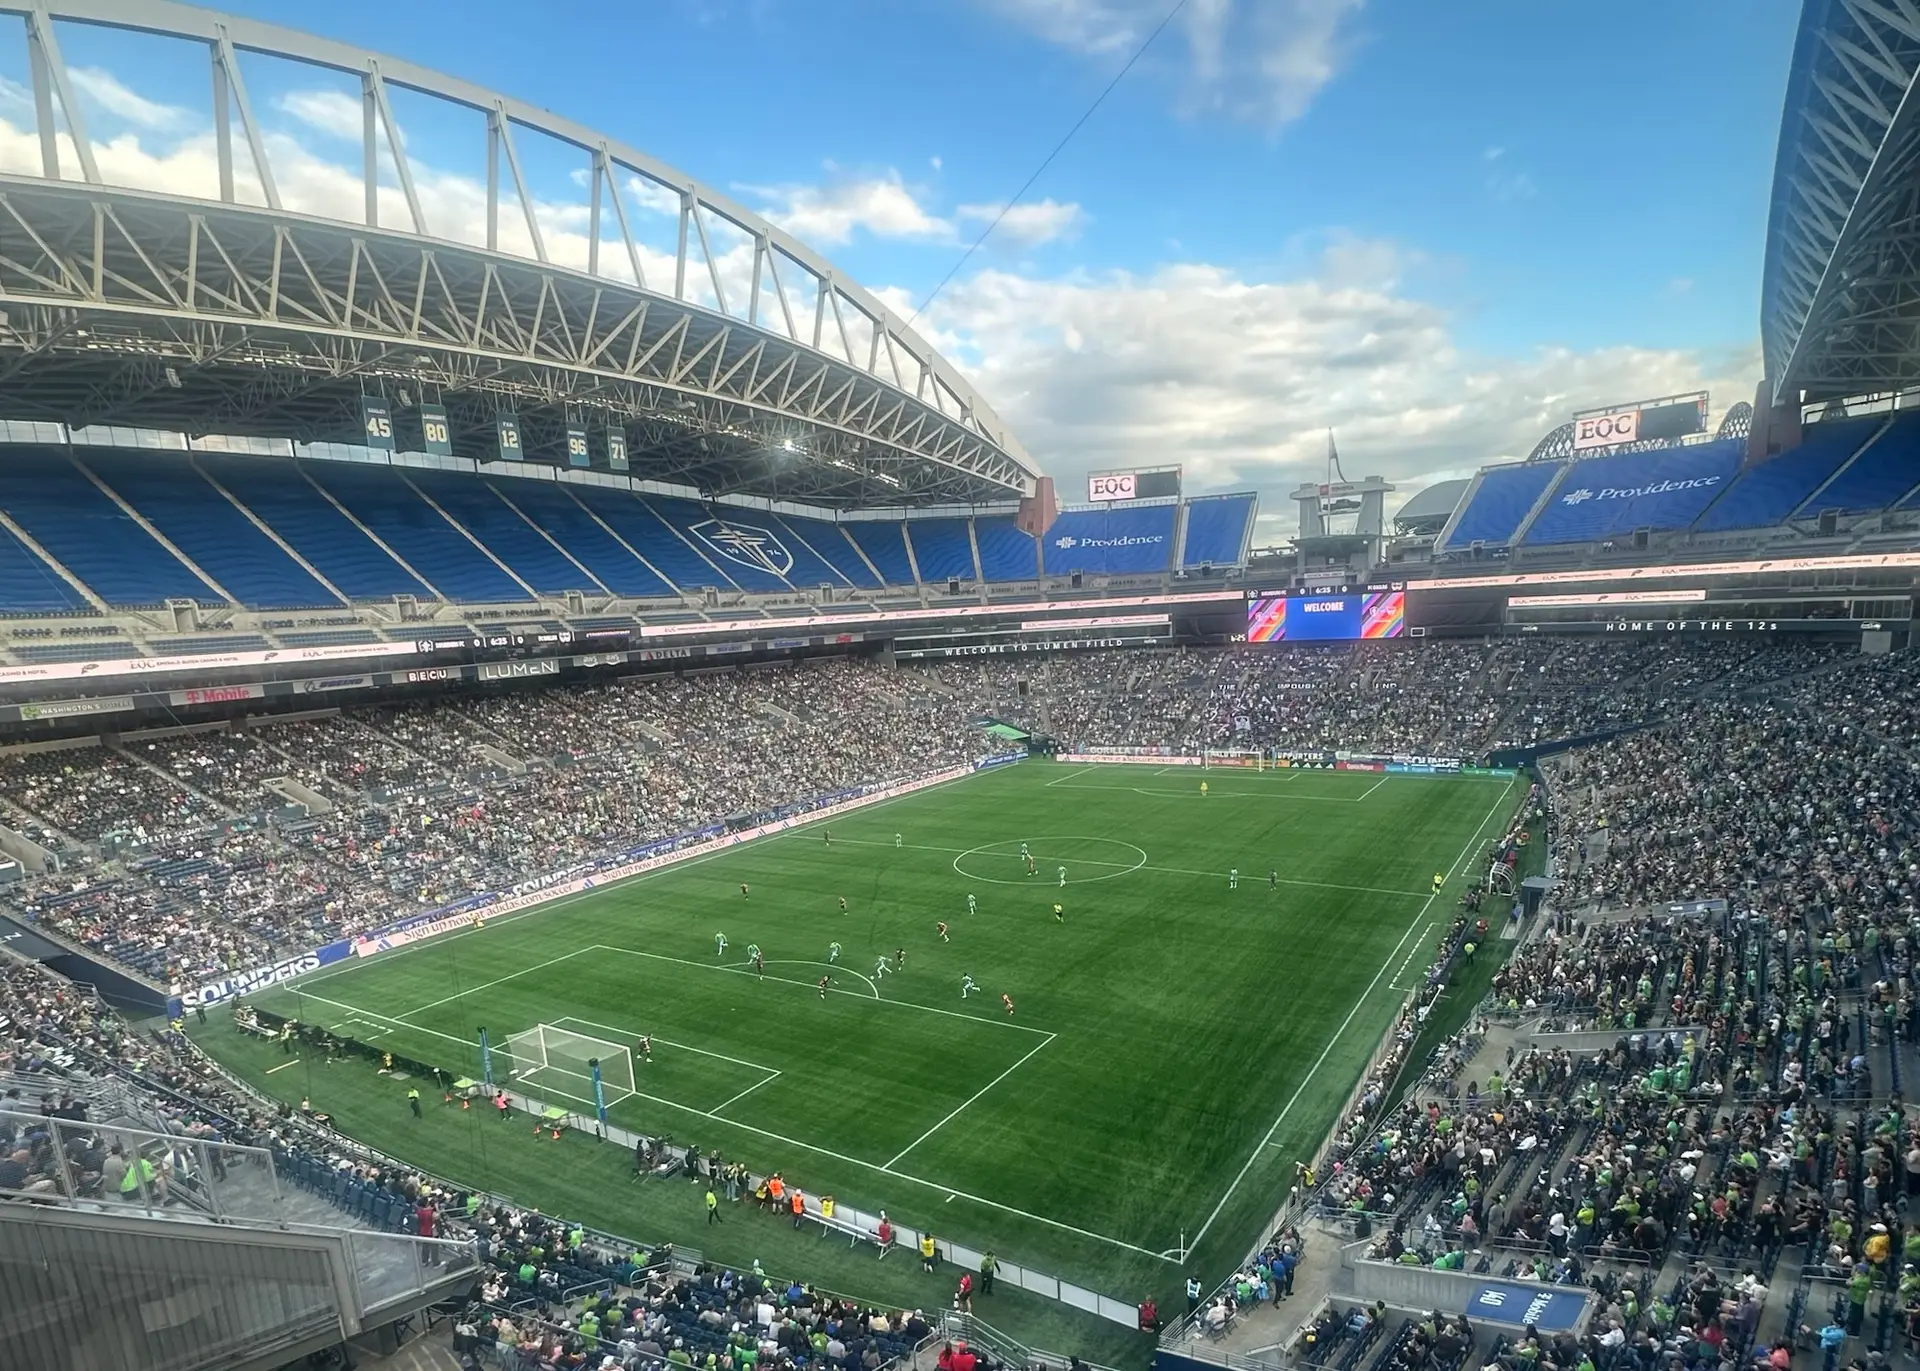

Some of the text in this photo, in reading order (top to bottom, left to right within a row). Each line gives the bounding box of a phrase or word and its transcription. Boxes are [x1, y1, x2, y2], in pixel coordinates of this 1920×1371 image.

[368, 417, 391, 438] 45
[426, 423, 448, 442] 80
[1580, 414, 1631, 442] EQC
[501, 430, 519, 448] 12
[570, 438, 587, 456] 96
[610, 443, 626, 460] 71
[1094, 477, 1132, 497] EQC
[1596, 476, 1720, 501] Providence
[1081, 535, 1162, 548] Providence
[1304, 602, 1344, 612] WELCOME
[1606, 621, 1778, 632] HOME OF THE 12s
[474, 638, 480, 647] 0
[518, 636, 524, 644] 0
[945, 646, 1005, 656] WELCOME
[1036, 641, 1078, 650] LUMEN
[1086, 640, 1123, 648] FIELD
[656, 648, 687, 659] DELTA
[130, 660, 156, 670] EQC
[408, 669, 447, 681] BECU
[203, 687, 250, 702] Mobile
[40, 703, 100, 714] WASHINGTON'S
[1090, 746, 1130, 754] GORILLA
[1275, 752, 1323, 760] UPPORTERS
[141, 833, 172, 844] DELTA
[603, 870, 621, 881] Sign
[622, 866, 634, 876] up
[634, 861, 652, 870] now
[404, 928, 430, 942] Sign
[433, 920, 447, 932] up
[448, 916, 470, 928] now
[182, 951, 320, 1008] SOUNDERS
[1522, 1298, 1548, 1325] Mobile
